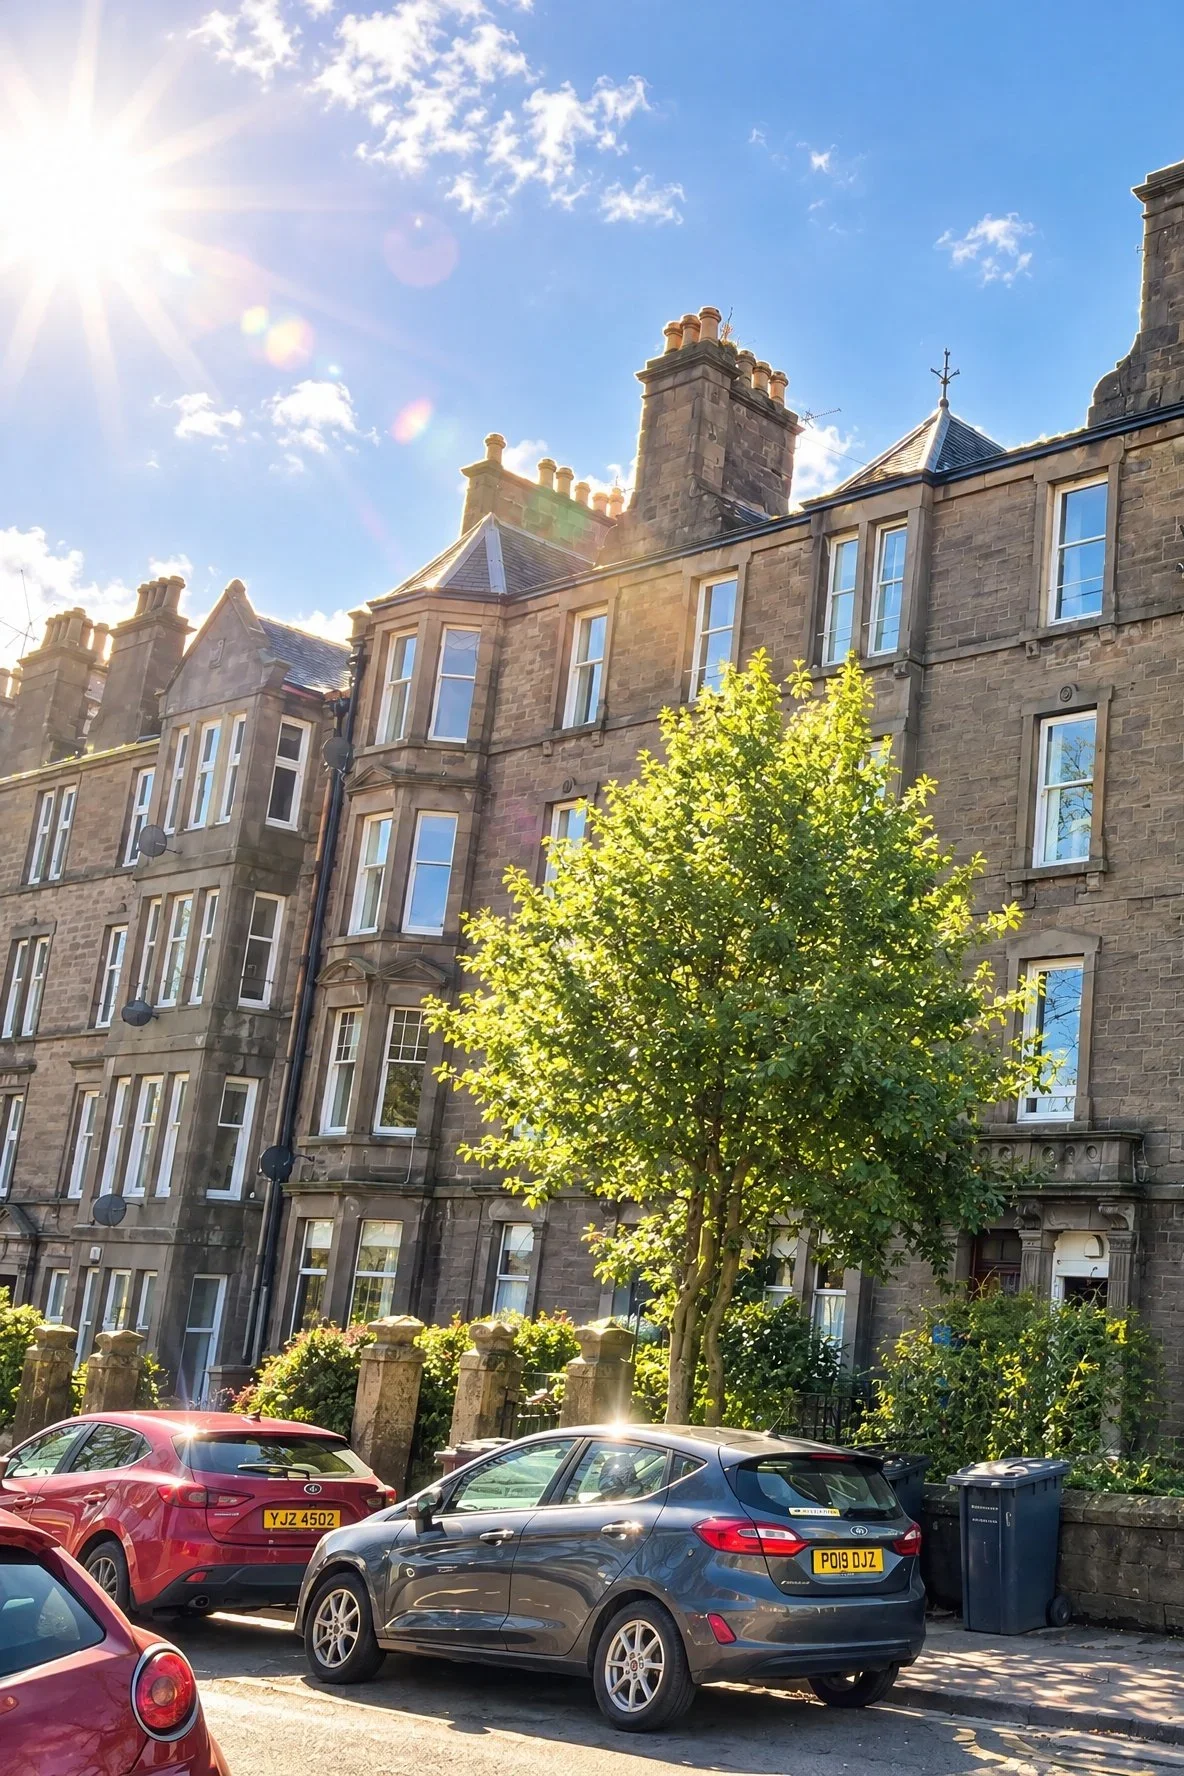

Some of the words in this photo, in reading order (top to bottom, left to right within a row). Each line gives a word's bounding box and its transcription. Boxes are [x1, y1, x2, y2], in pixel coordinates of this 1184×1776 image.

[270, 1512, 297, 1526] YJZ
[301, 1512, 335, 1526] 4502
[853, 1551, 877, 1569] DJZ
